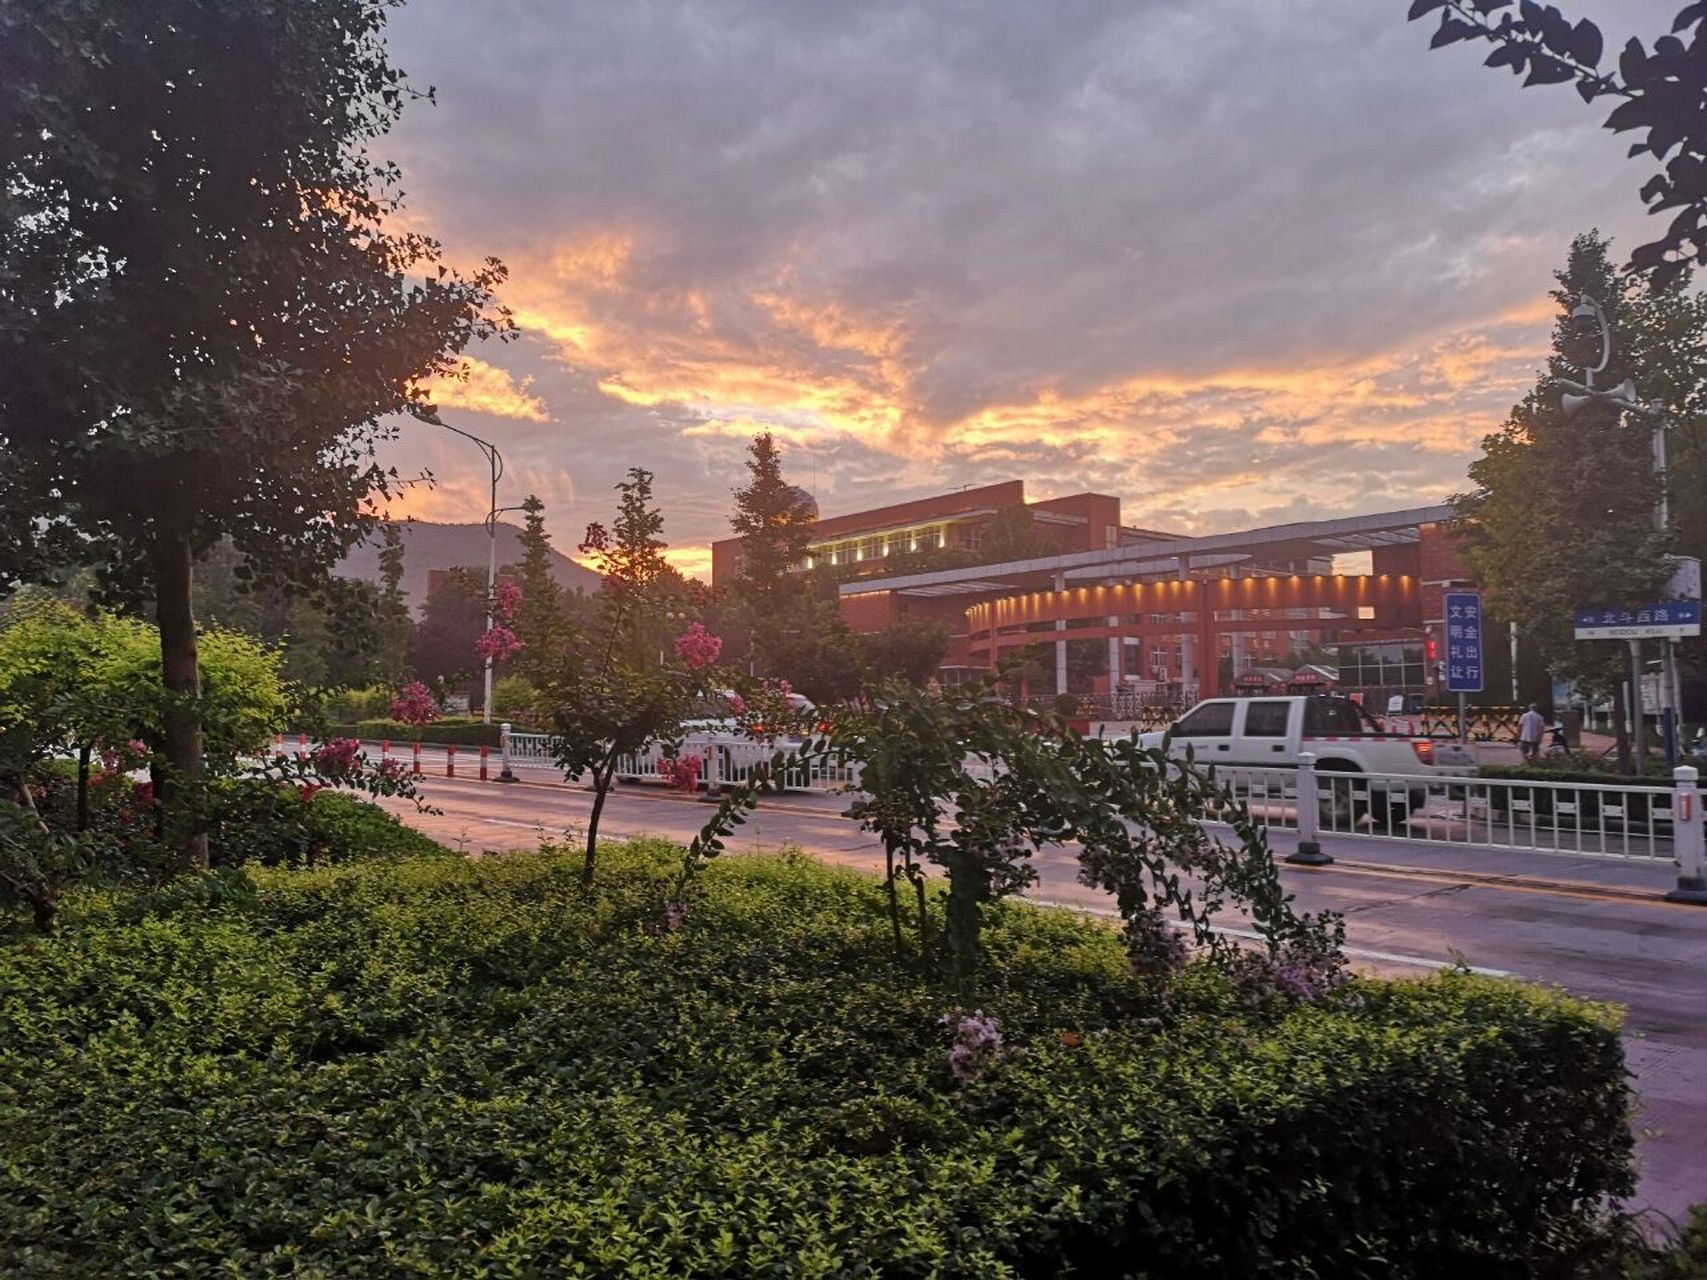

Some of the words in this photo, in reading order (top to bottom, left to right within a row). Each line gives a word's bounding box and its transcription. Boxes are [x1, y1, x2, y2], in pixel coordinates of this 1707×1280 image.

[1450, 605, 1464, 679] 文明礼让
[1464, 605, 1480, 679] 安全出行
[1601, 608, 1670, 624] 北斗西路
